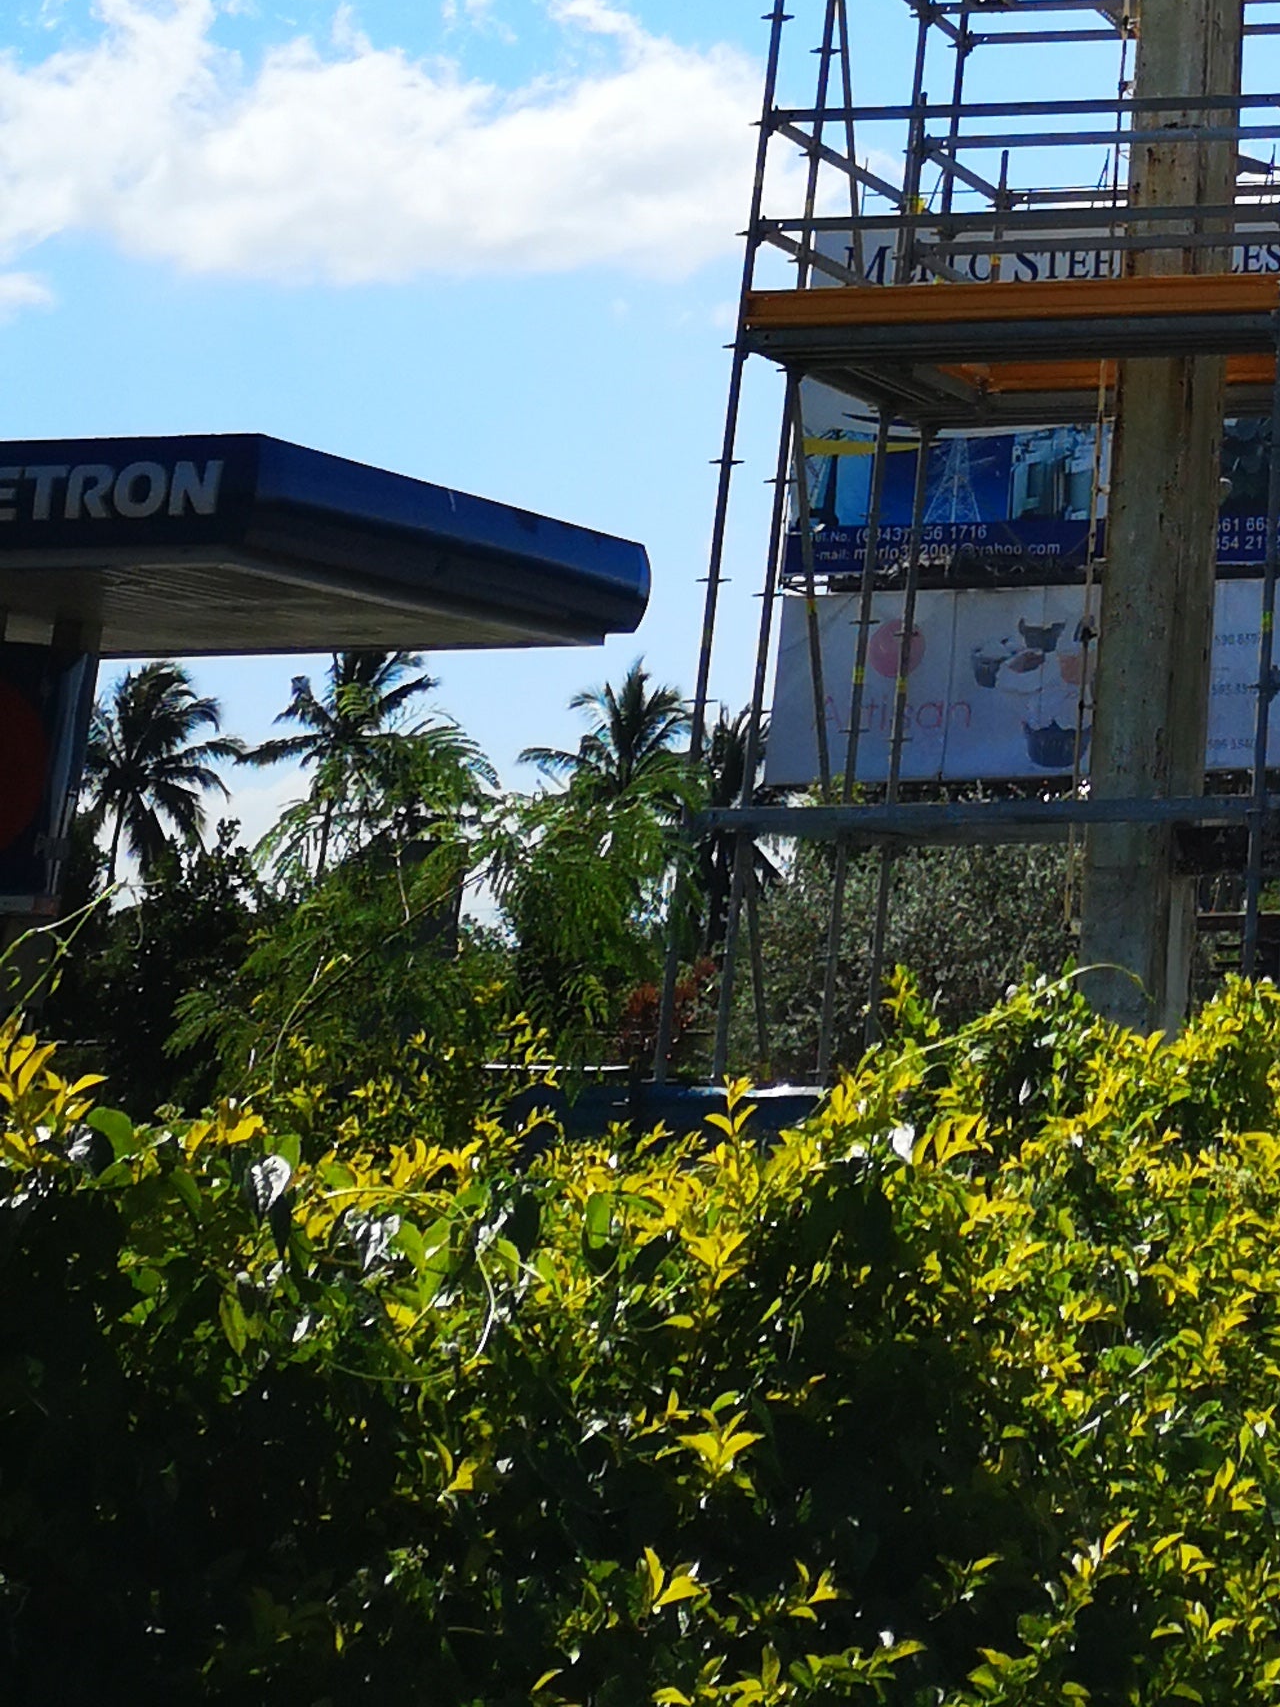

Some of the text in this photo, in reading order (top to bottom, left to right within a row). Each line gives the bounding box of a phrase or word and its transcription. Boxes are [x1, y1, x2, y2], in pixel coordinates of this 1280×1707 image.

[1014, 250, 1122, 282] STEE
[949, 524, 988, 540] 1716
[1217, 517, 1240, 532] 61
[812, 548, 850, 561] -mail:
[811, 695, 972, 732] Atian
